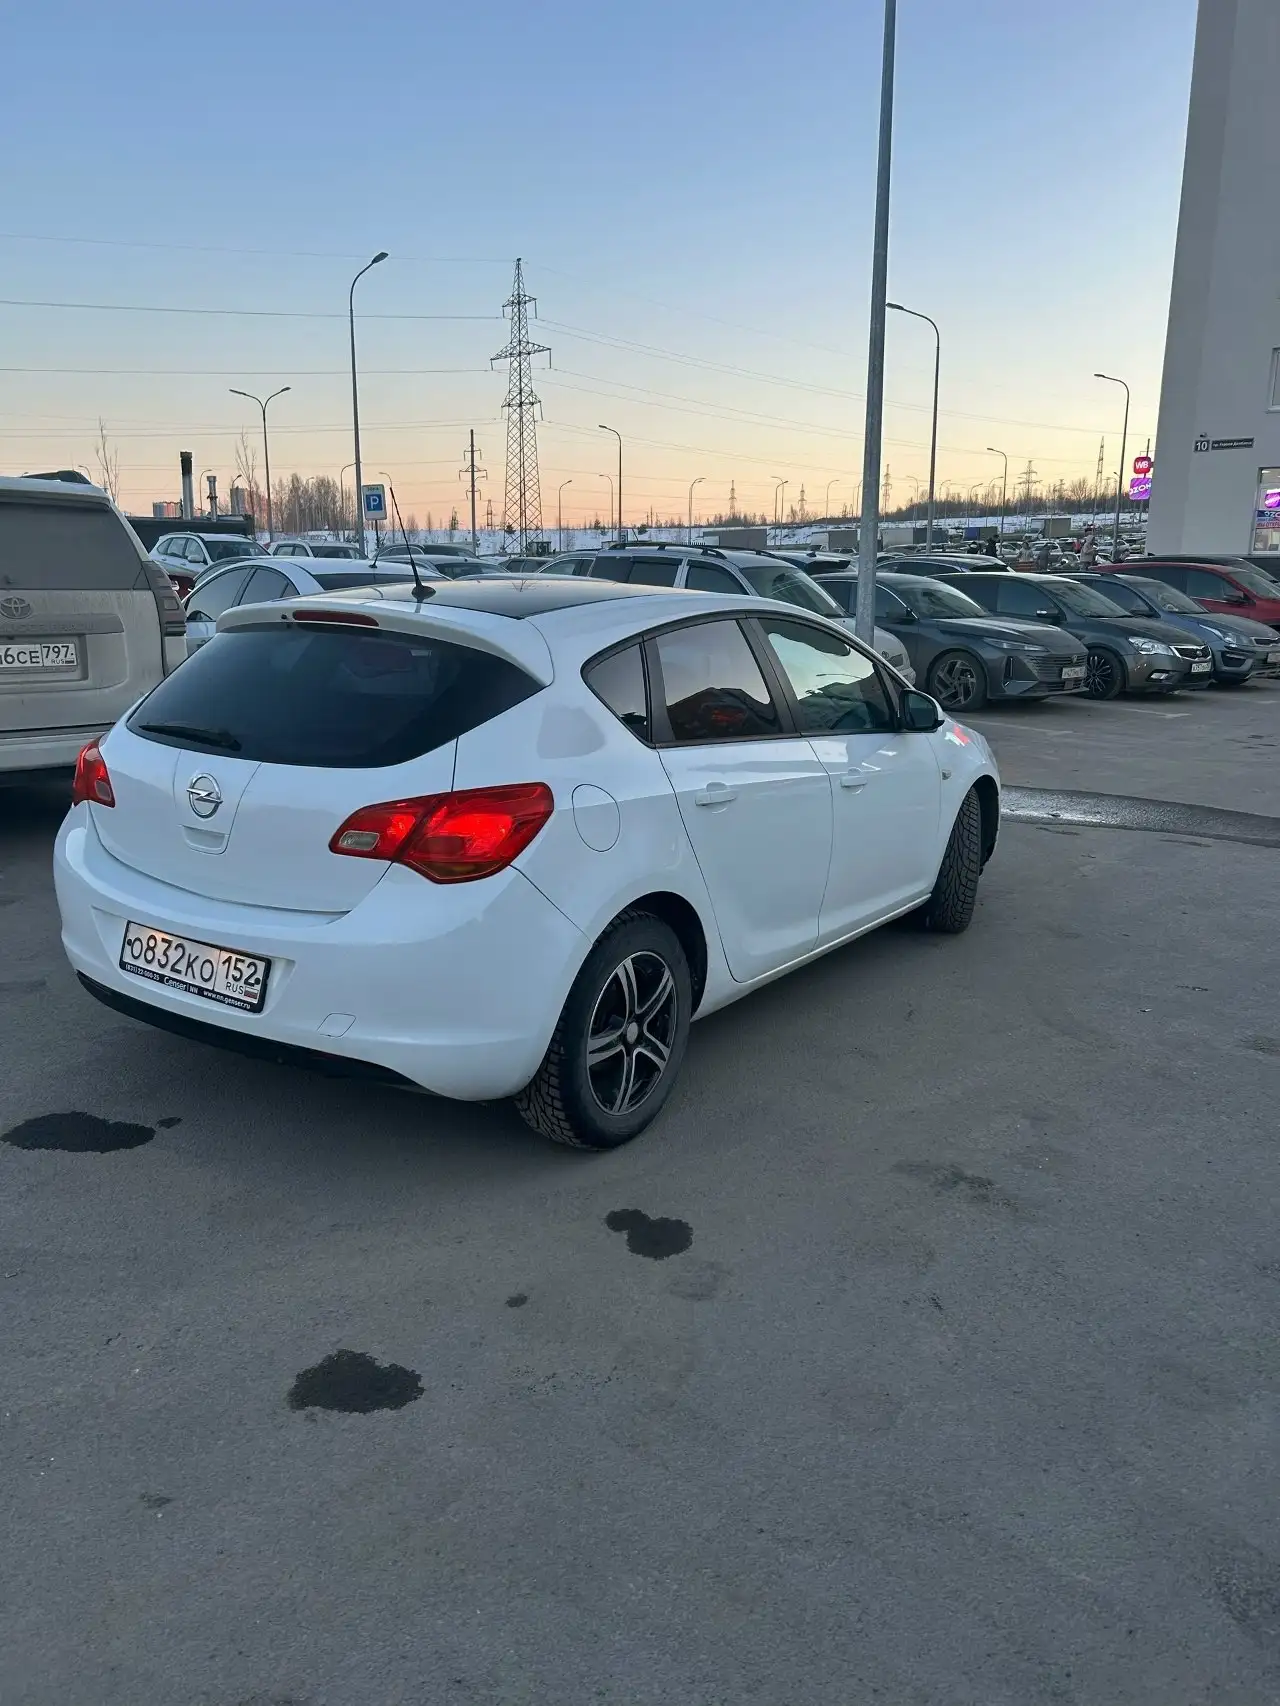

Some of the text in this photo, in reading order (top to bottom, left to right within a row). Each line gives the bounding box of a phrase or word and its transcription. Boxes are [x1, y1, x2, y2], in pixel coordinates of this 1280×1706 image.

[1196, 441, 1208, 451] 10
[1135, 461, 1149, 469] WB
[370, 496, 379, 509] P
[43, 645, 70, 659] 797
[222, 955, 257, 988] 152
[225, 981, 244, 995] RUS
